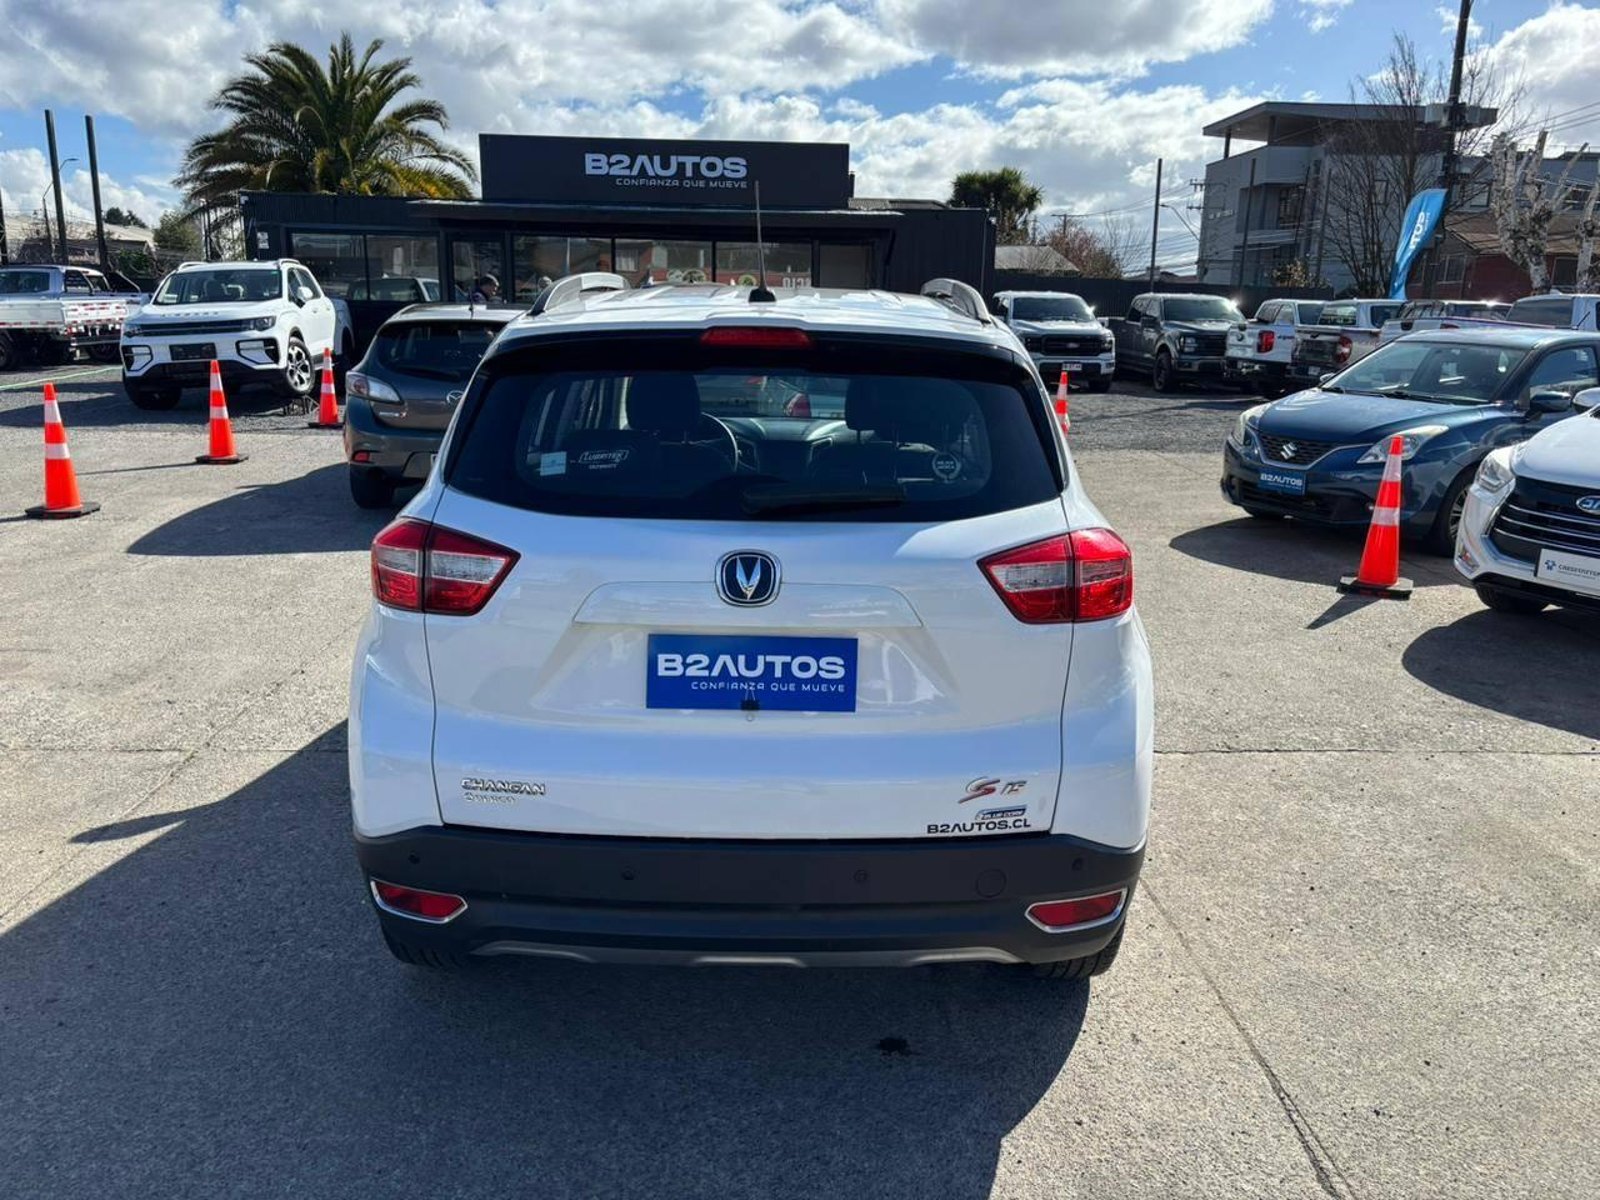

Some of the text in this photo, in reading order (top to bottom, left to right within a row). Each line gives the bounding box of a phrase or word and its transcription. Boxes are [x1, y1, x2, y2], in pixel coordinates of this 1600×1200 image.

[584, 153, 748, 178] B2AUTOS
[615, 178, 748, 189] CONFIANZA QUE MUEVE
[657, 653, 846, 679] B2AUTOS
[691, 681, 846, 693] CONFIANZA QUE MUEVE
[460, 777, 546, 796] CHANGAN
[927, 818, 1031, 834] B2AUTOS.CL
